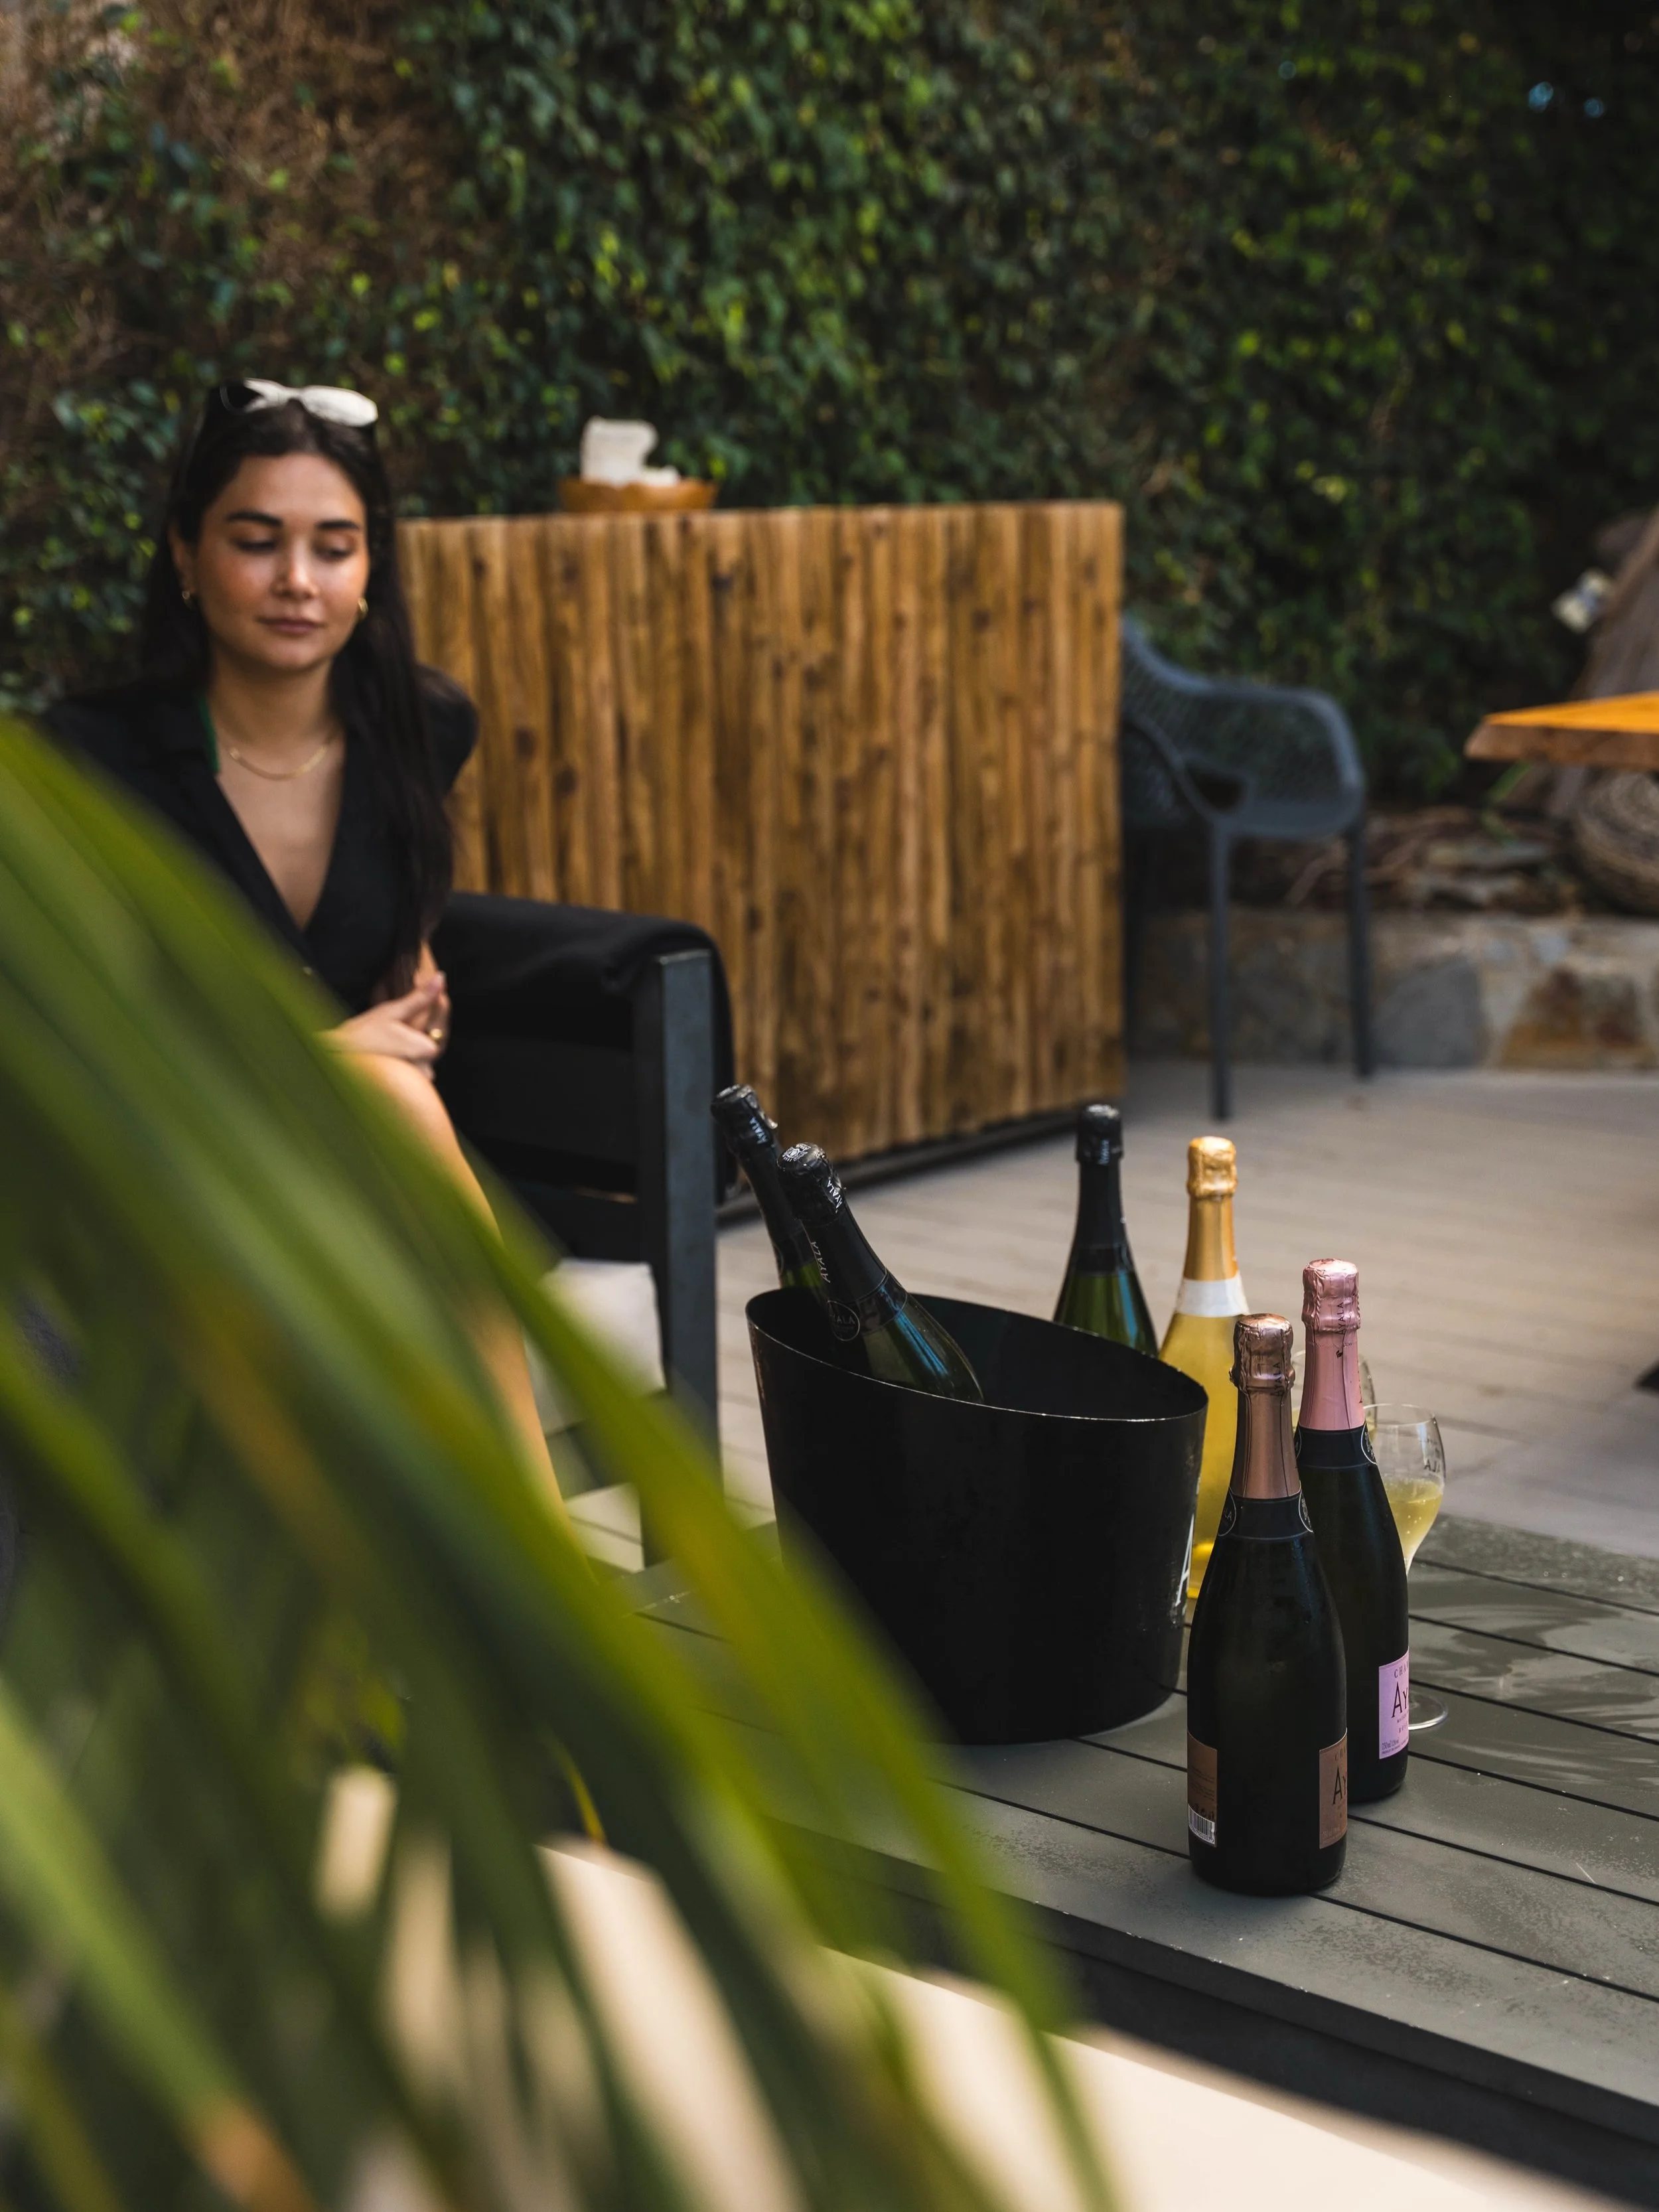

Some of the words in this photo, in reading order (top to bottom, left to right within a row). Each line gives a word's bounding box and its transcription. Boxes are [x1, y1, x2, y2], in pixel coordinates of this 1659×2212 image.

[827, 1180, 843, 1209] AYALA
[810, 1241, 831, 1283] AYALA
[1335, 1302, 1346, 1335] AYALA
